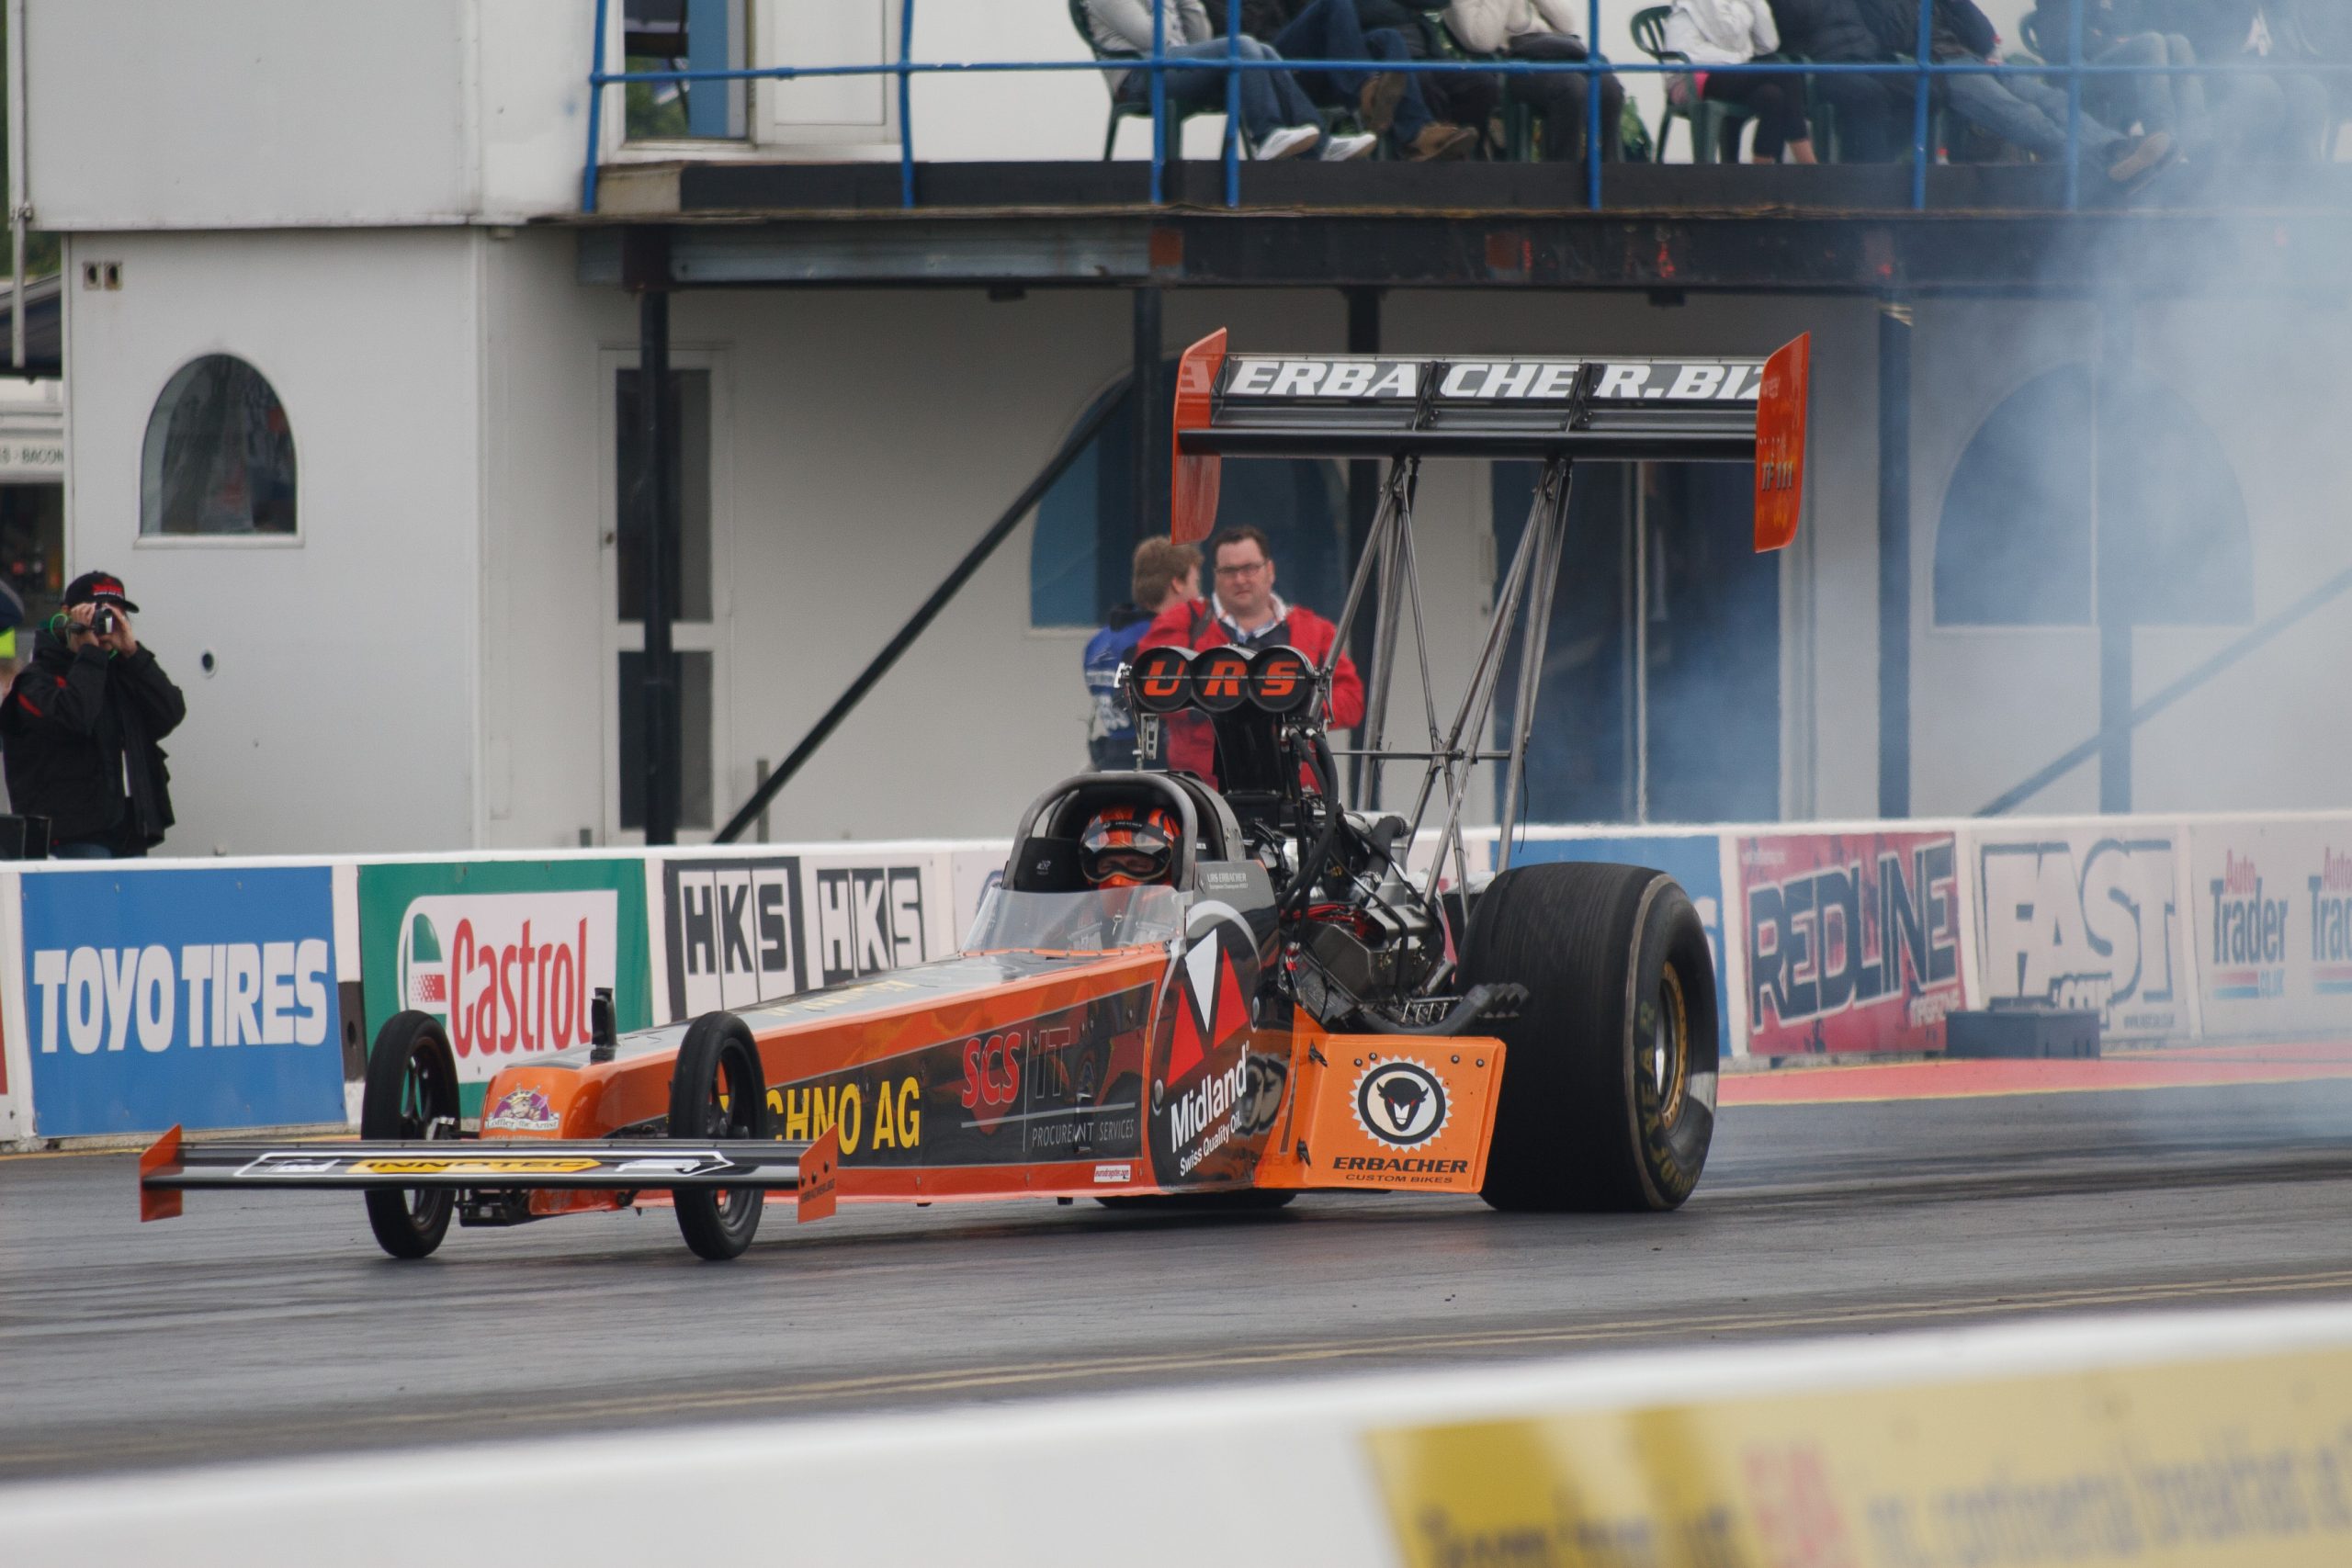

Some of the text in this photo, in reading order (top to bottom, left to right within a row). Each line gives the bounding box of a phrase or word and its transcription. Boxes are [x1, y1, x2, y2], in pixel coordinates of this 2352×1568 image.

[2225, 849, 2256, 895] Auto
[683, 882, 788, 976] HKS
[819, 878, 924, 972] HKS
[1747, 838, 1958, 1035] REDLINE
[1980, 839, 2176, 1002] FAST
[2211, 876, 2289, 964] Trader
[34, 939, 328, 1055] TOYO TIRES
[450, 916, 592, 1059] Castrol
[961, 1027, 1071, 1109] SCS IT
[872, 1076, 921, 1150] AG
[1032, 1119, 1135, 1146] PROCURENT SERVICES
[1180, 1145, 1203, 1177] Swiss
[1203, 1122, 1230, 1156] Quality
[1333, 1156, 1469, 1174] ERBACHER
[1345, 1173, 1453, 1184] CUSTOM BIKES
